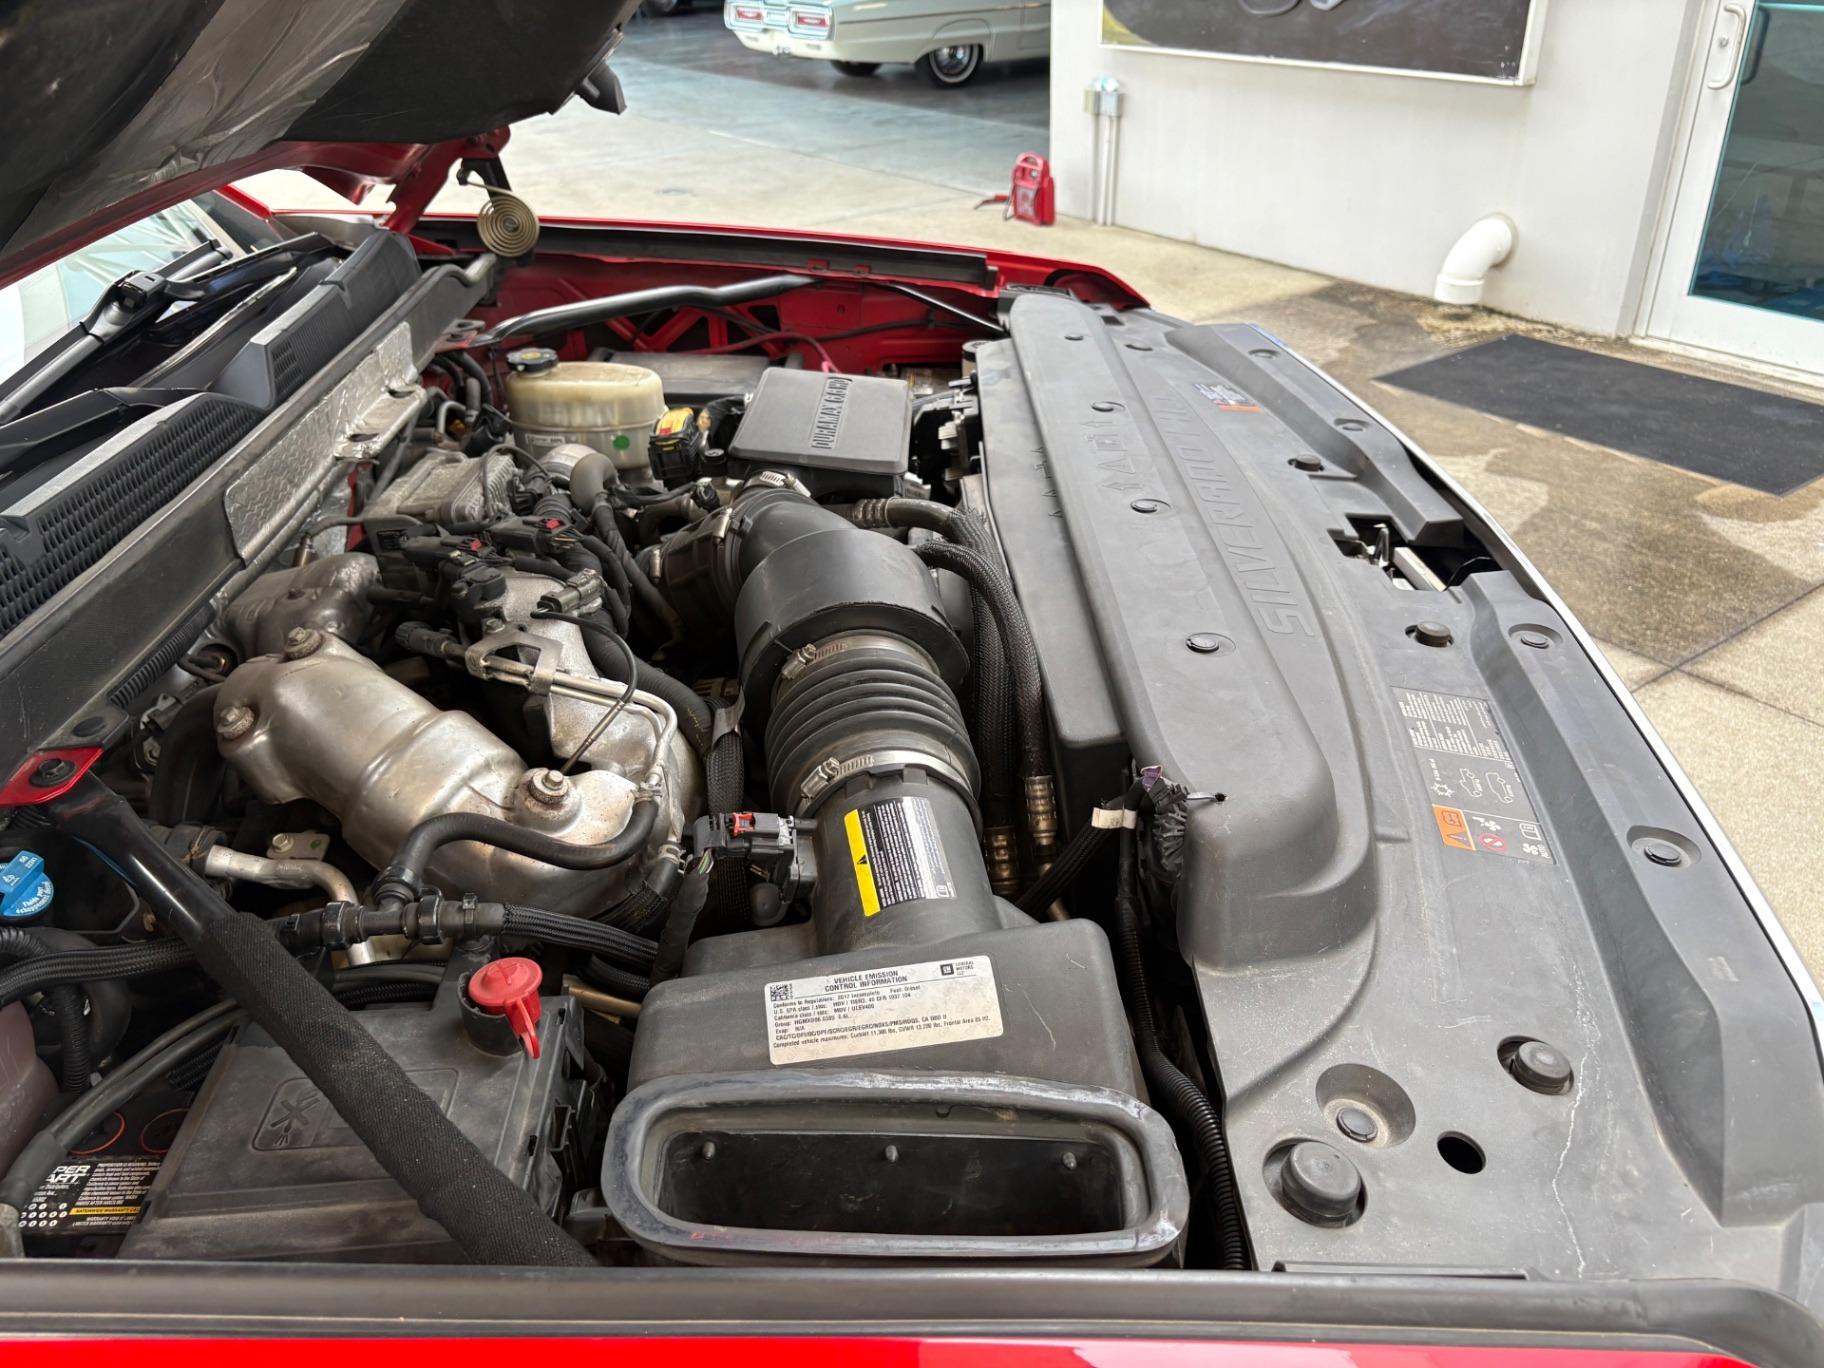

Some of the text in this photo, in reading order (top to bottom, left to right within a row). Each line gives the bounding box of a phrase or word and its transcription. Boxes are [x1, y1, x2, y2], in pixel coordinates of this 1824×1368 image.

[1176, 442, 1317, 638] SILVERADO
[833, 970, 898, 985] VEHICLE EMISSION
[824, 976, 908, 992] CONTROL INFORMATION
[773, 1040, 800, 1048] Completed
[53, 1165, 91, 1174] PER
[45, 1174, 87, 1183] ART
